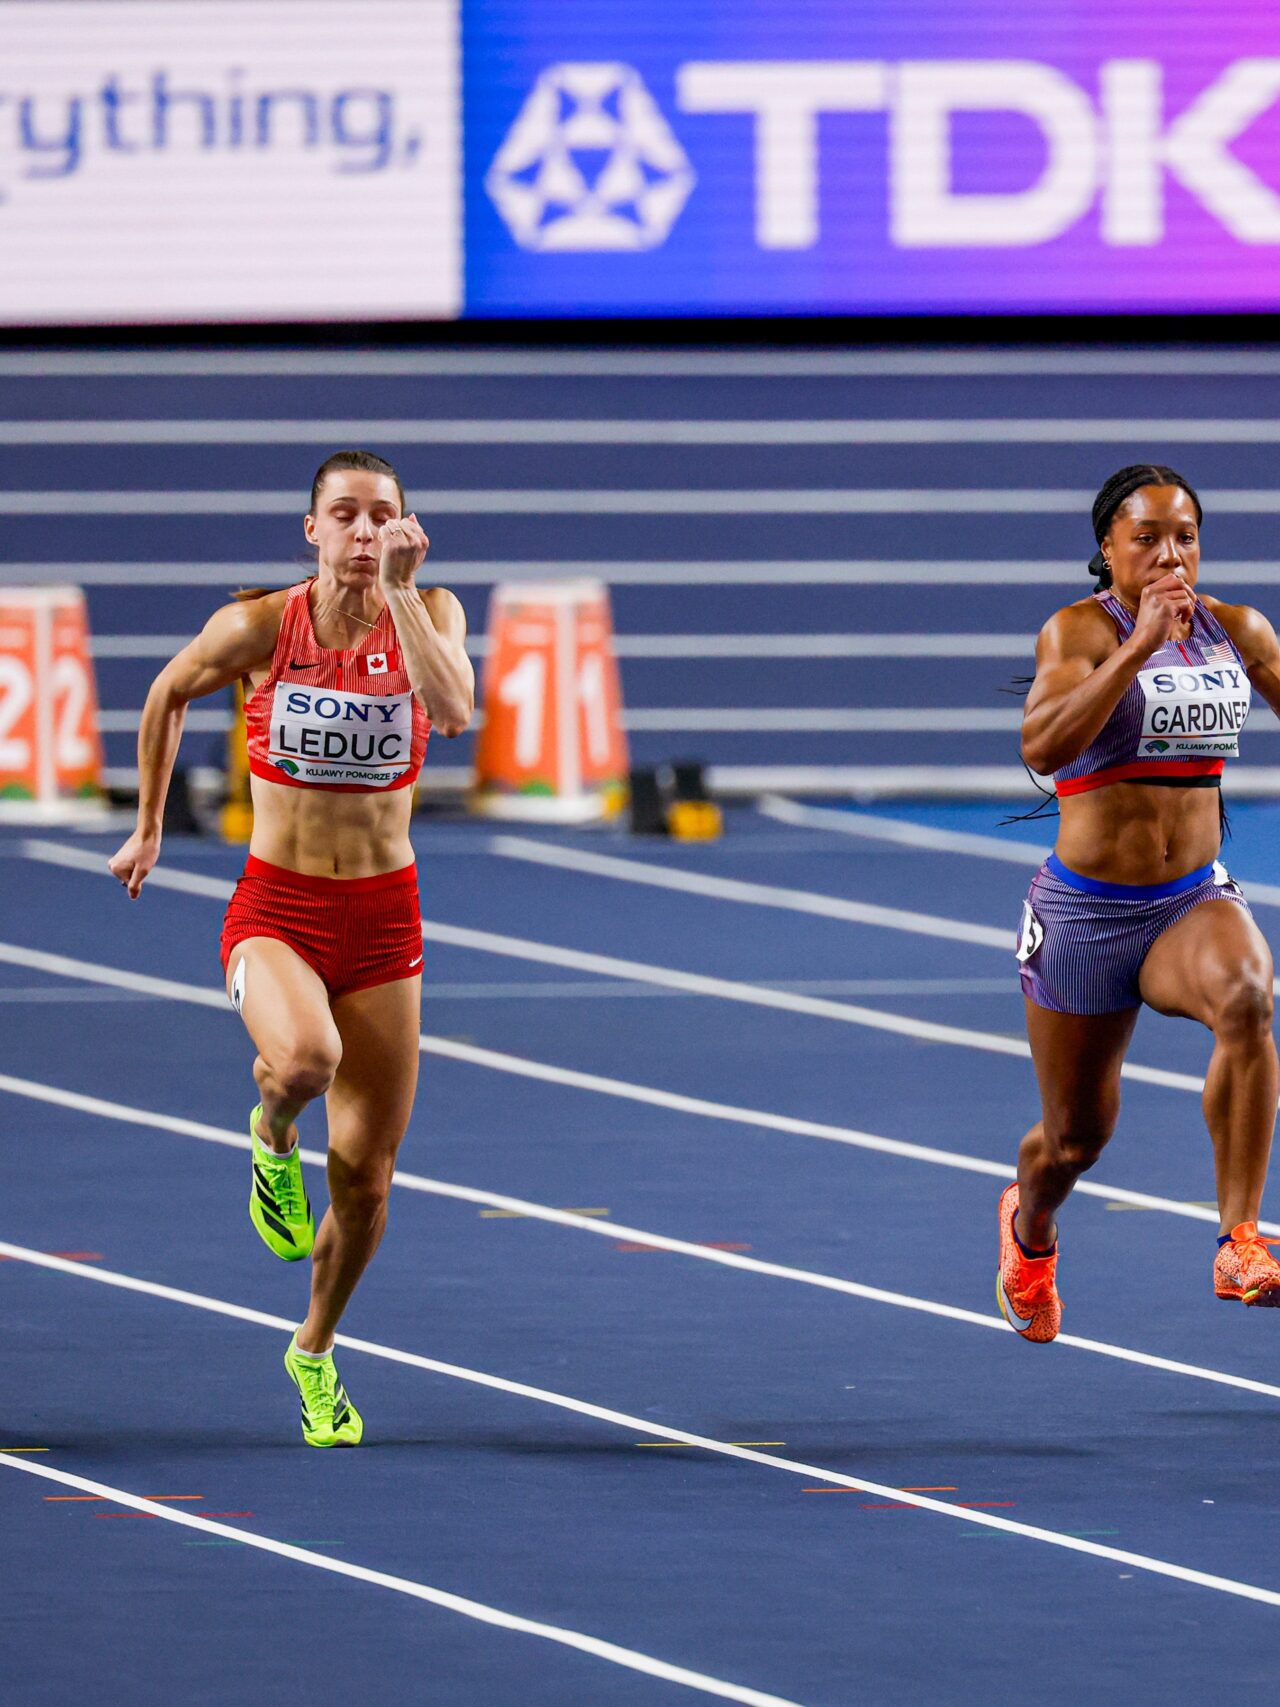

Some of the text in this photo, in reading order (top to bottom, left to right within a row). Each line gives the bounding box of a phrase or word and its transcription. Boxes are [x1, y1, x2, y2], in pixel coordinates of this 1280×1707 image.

[0, 68, 422, 180] ything,
[1152, 669, 1240, 693] SONY
[286, 692, 400, 723] SONY
[279, 725, 402, 761] LEDUC
[1175, 743, 1212, 751] KUJAWY
[305, 768, 344, 778] KUJAWY
[345, 770, 390, 781] POMORZE
